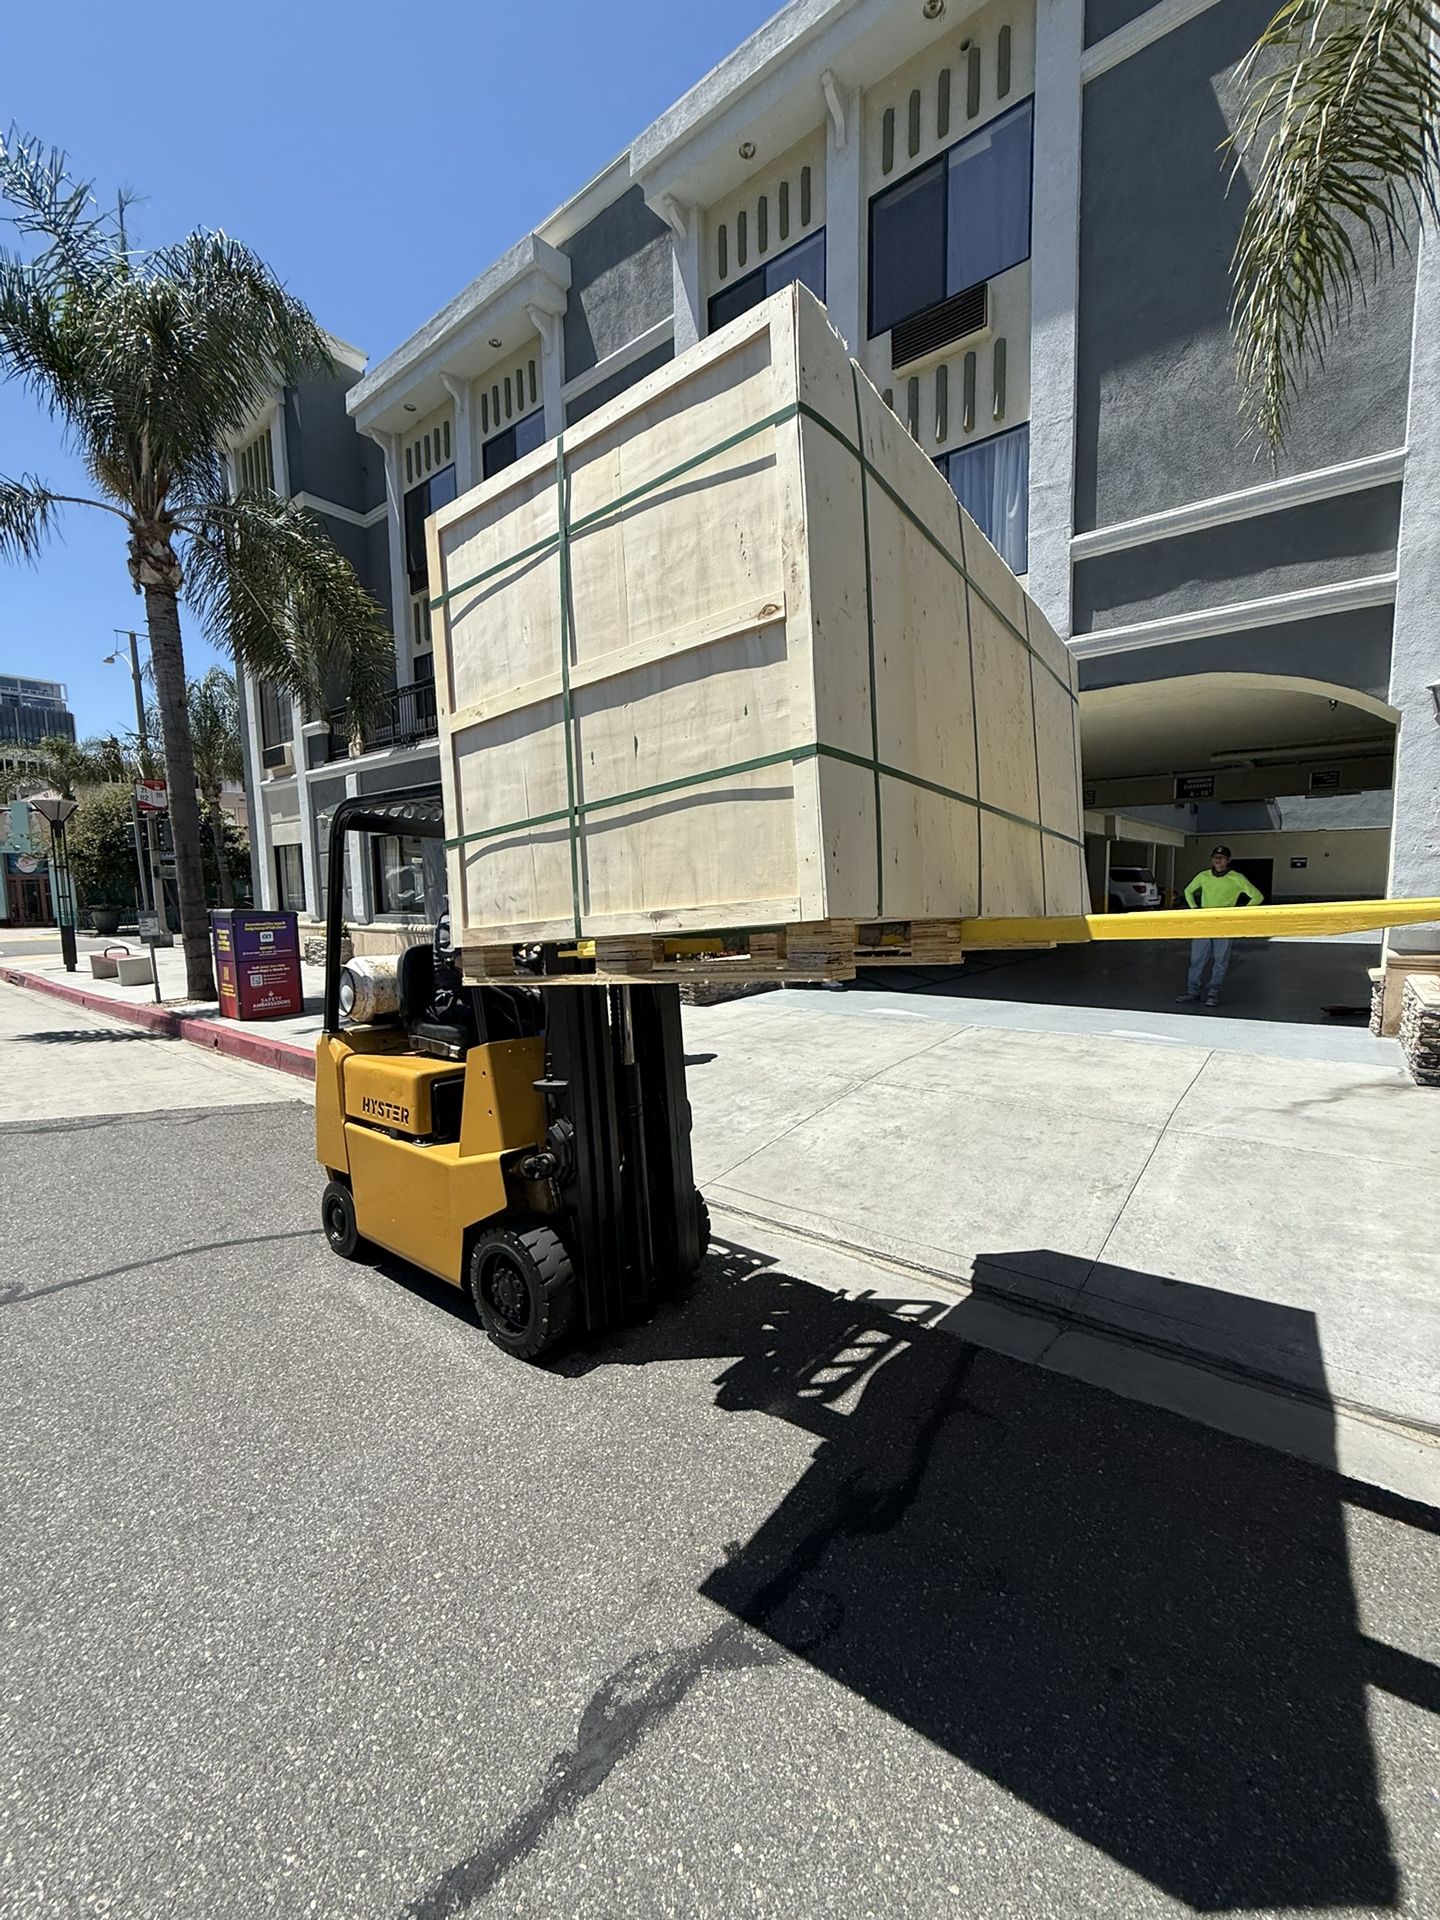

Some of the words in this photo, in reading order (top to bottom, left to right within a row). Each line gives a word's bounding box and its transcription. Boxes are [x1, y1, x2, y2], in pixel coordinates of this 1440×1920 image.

[1183, 782, 1213, 790] CLEARANCE
[252, 999, 292, 1009] AMBASSADORS
[362, 1096, 410, 1125] HYSTER
